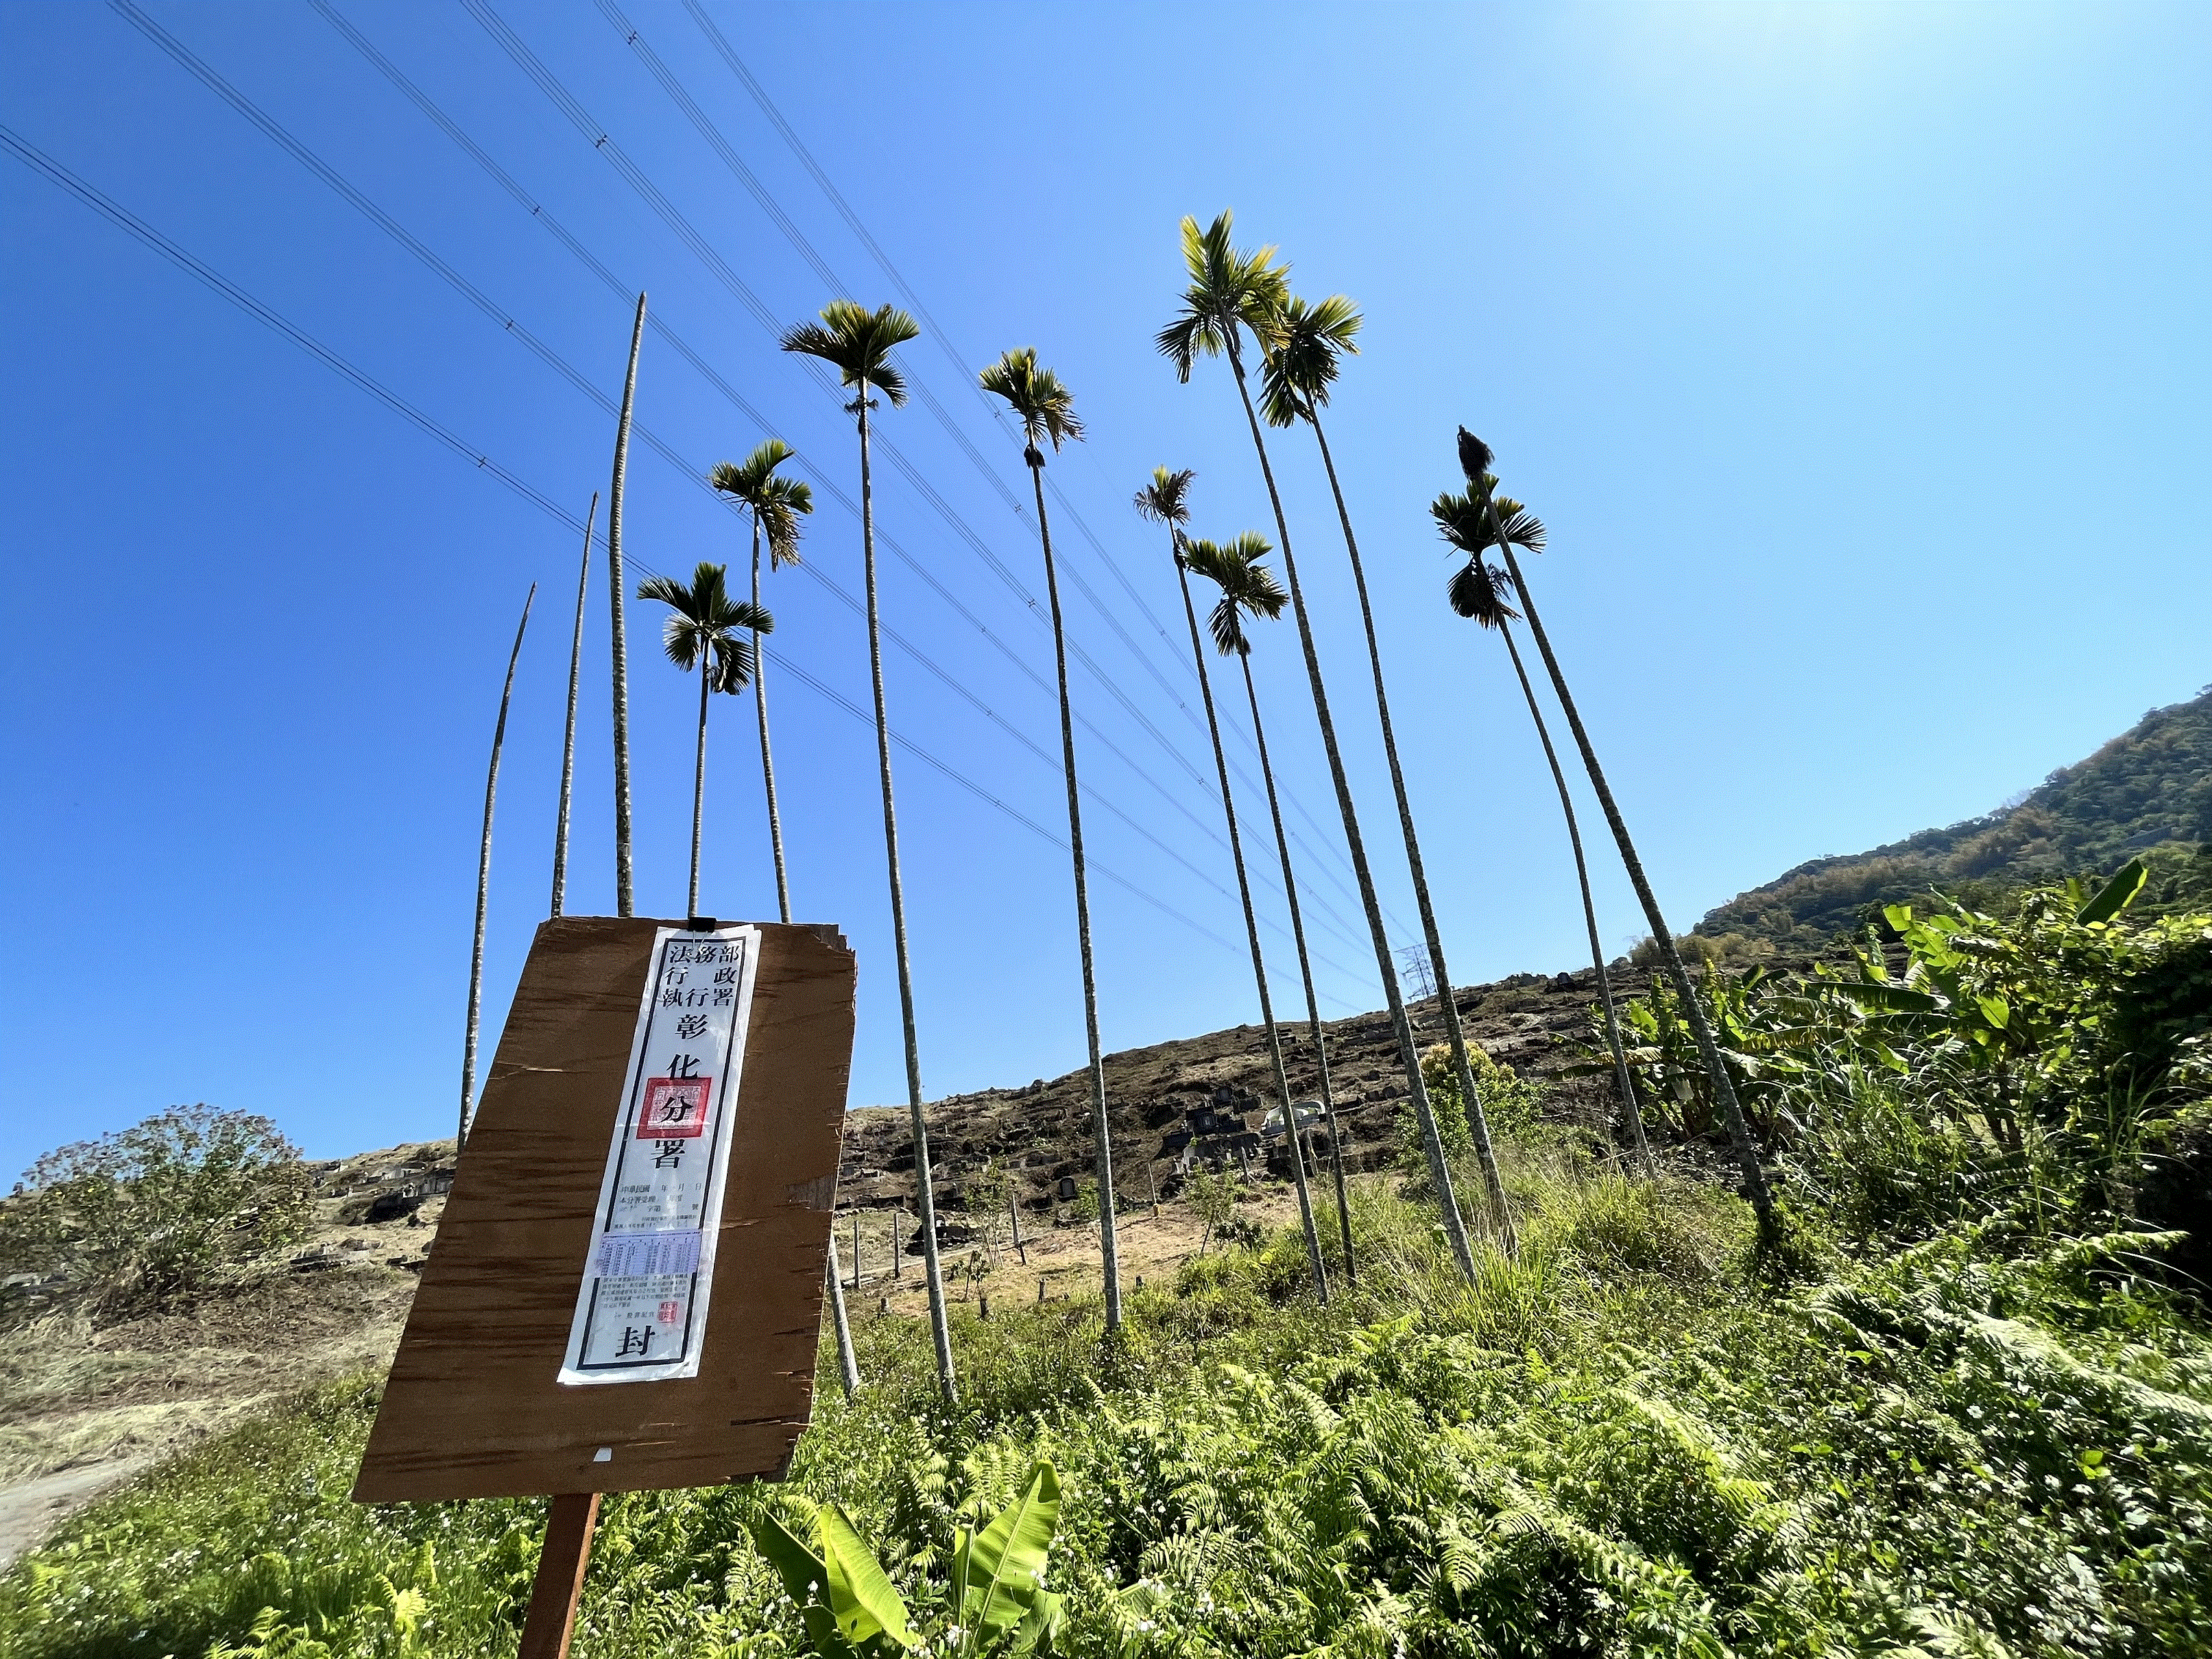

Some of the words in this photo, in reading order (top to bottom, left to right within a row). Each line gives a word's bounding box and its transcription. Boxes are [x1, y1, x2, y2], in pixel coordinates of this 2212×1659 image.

[669, 945, 739, 963] 法務部
[662, 988, 733, 1008] 執行署
[651, 1014, 708, 1169] 彰化分署
[615, 1325, 656, 1357] 封
